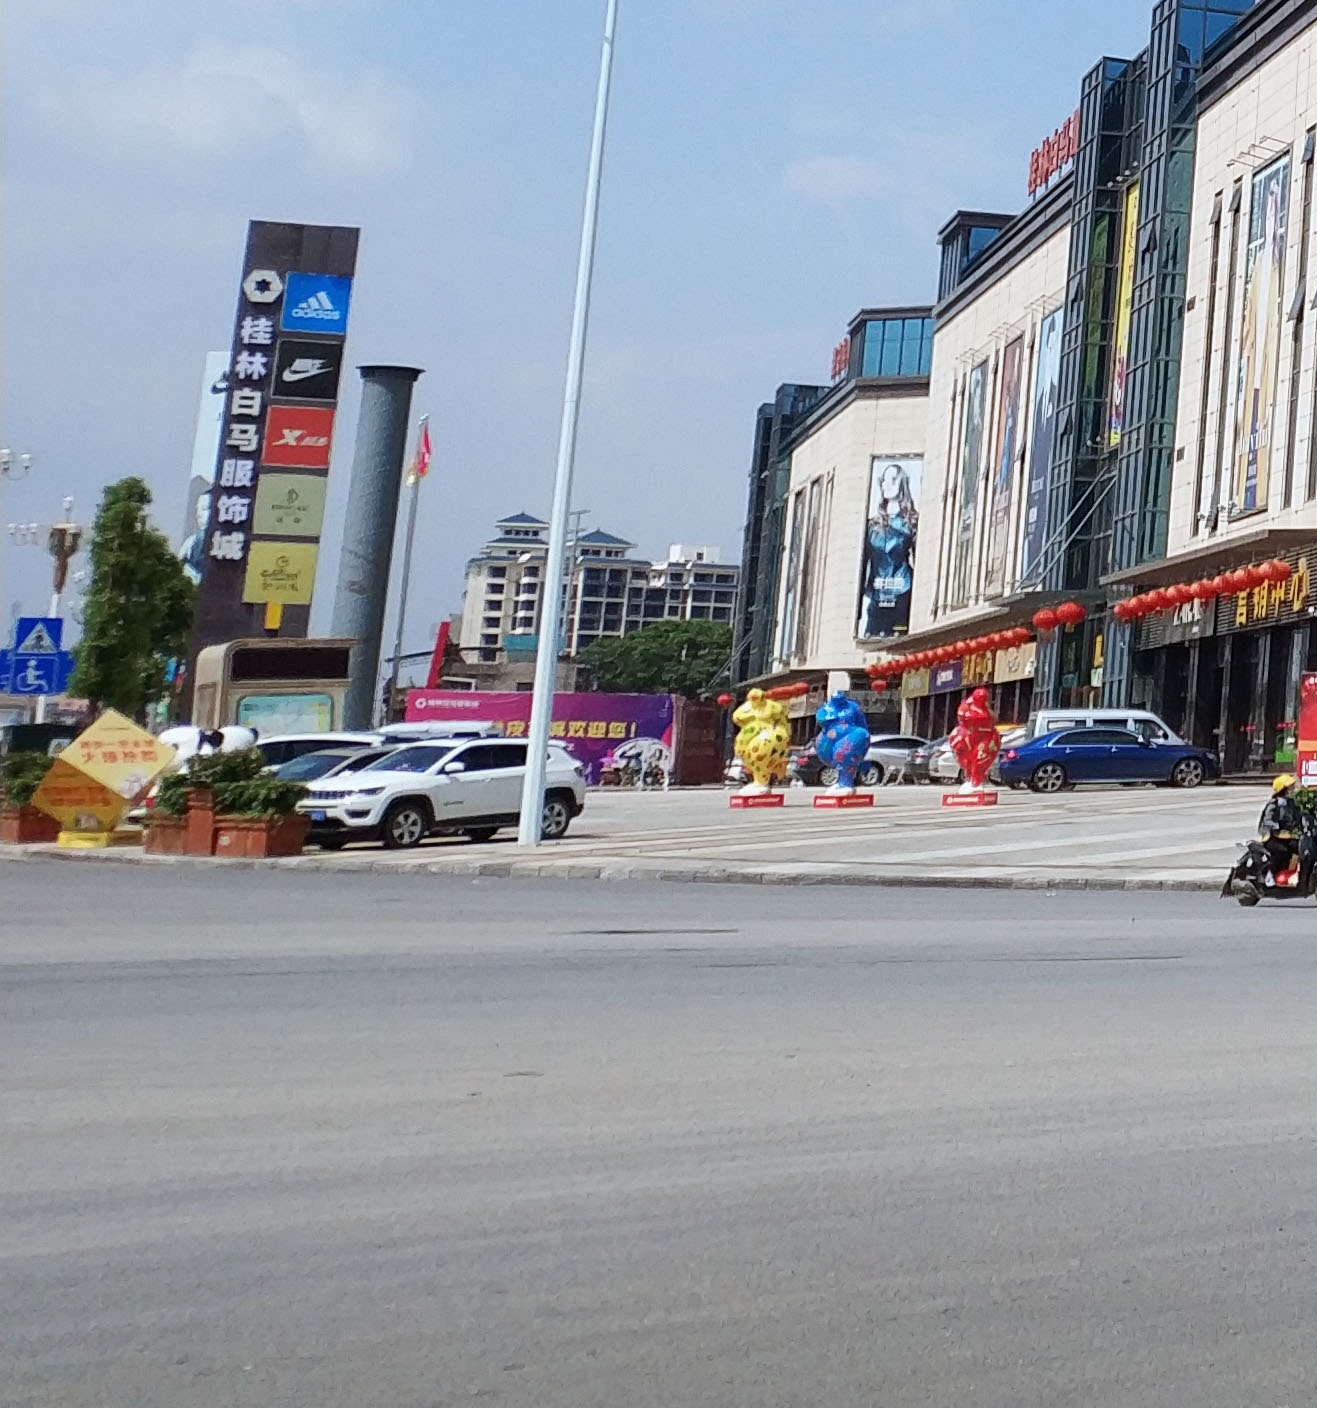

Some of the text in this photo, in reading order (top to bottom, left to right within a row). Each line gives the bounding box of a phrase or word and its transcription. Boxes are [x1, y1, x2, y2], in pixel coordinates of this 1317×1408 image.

[210, 316, 274, 561] 桂林白马服饰城
